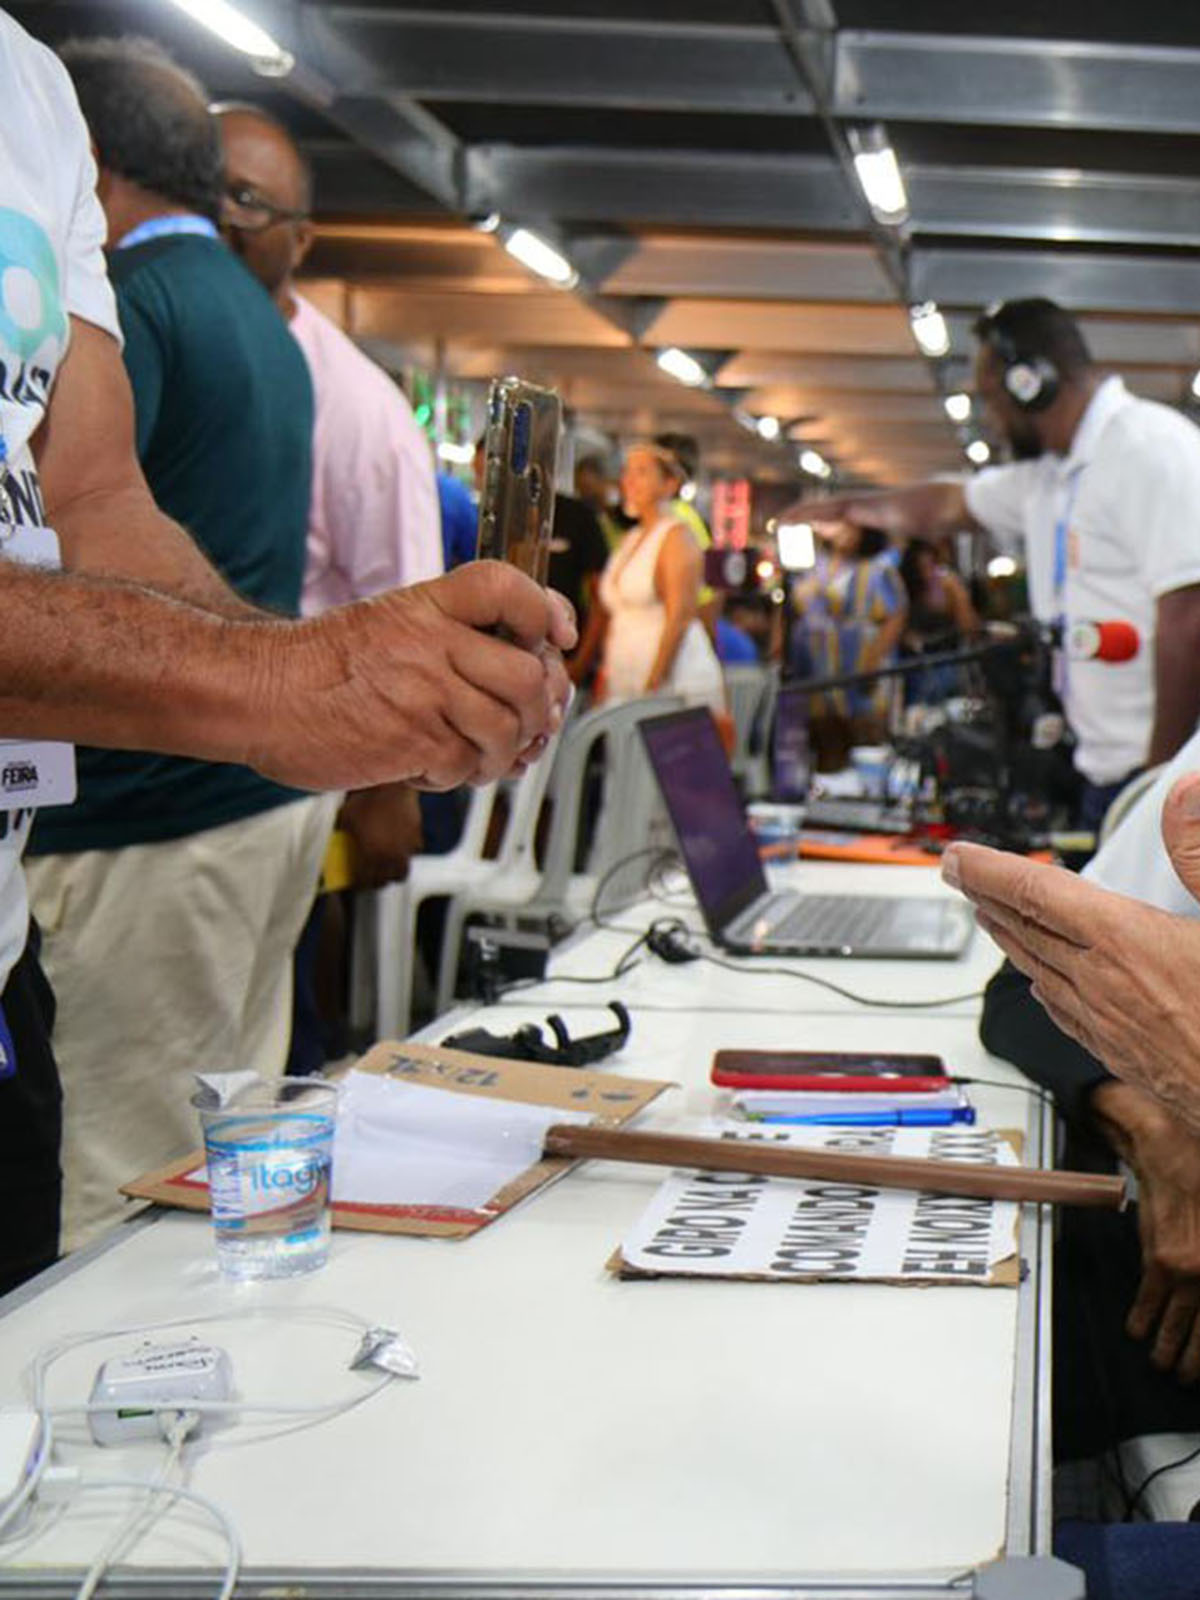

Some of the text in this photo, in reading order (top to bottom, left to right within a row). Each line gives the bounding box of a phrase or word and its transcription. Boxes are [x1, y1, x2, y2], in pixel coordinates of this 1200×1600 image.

[670, 1187, 764, 1215] NA
[642, 1214, 747, 1260] GIRO
[770, 1186, 880, 1275] COMANDO
[901, 1248, 989, 1276] EH
